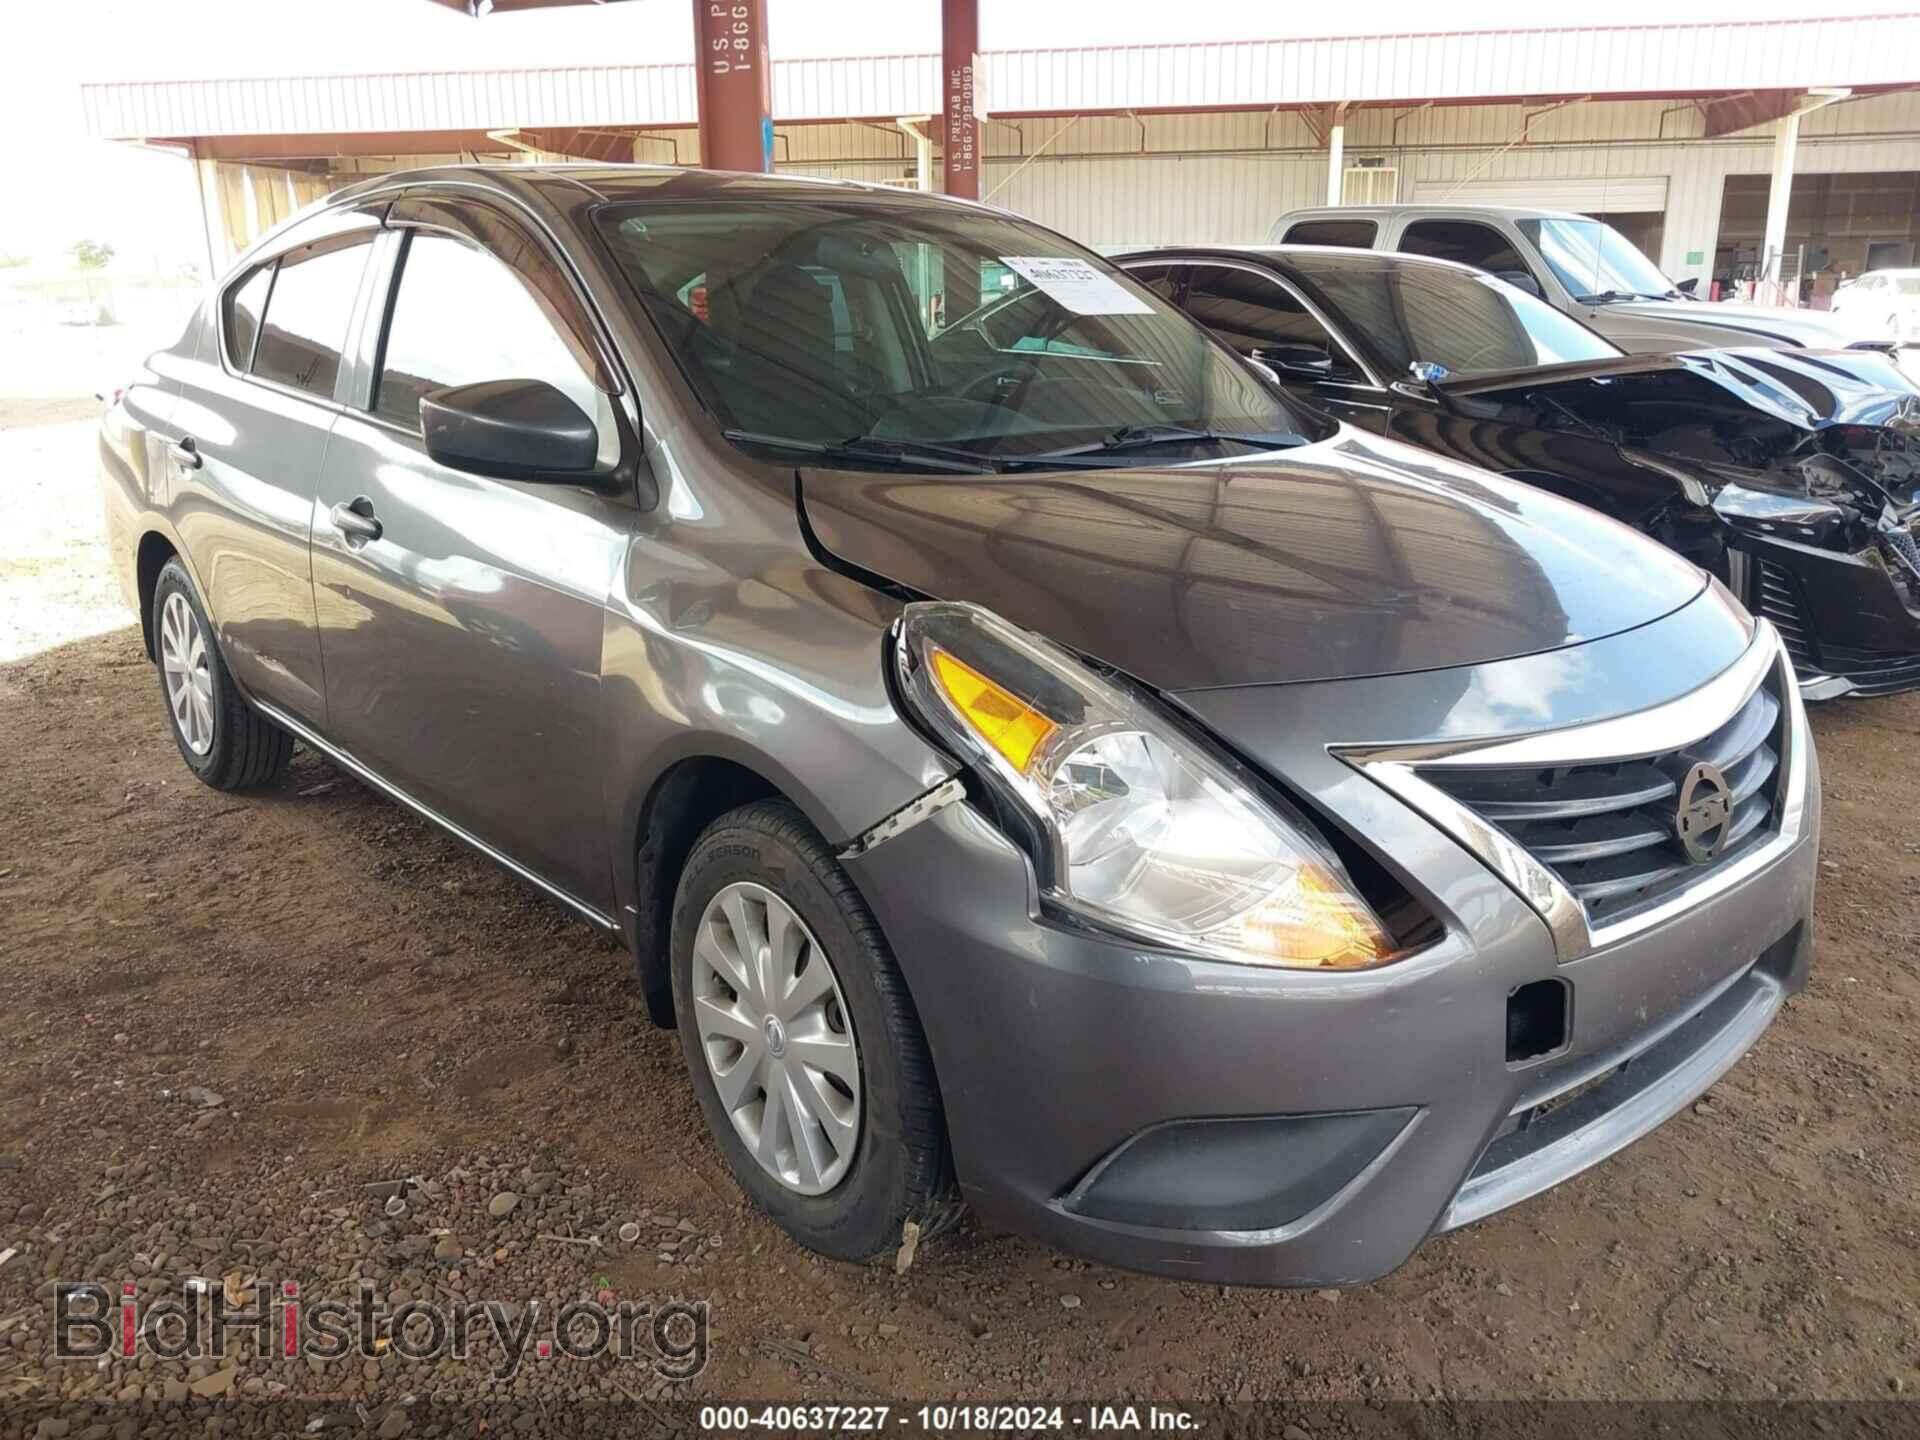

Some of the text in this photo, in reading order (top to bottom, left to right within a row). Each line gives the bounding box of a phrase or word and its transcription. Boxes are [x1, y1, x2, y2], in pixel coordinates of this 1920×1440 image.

[711, 0, 730, 74] U.S. P
[951, 95, 962, 143] PREFAB
